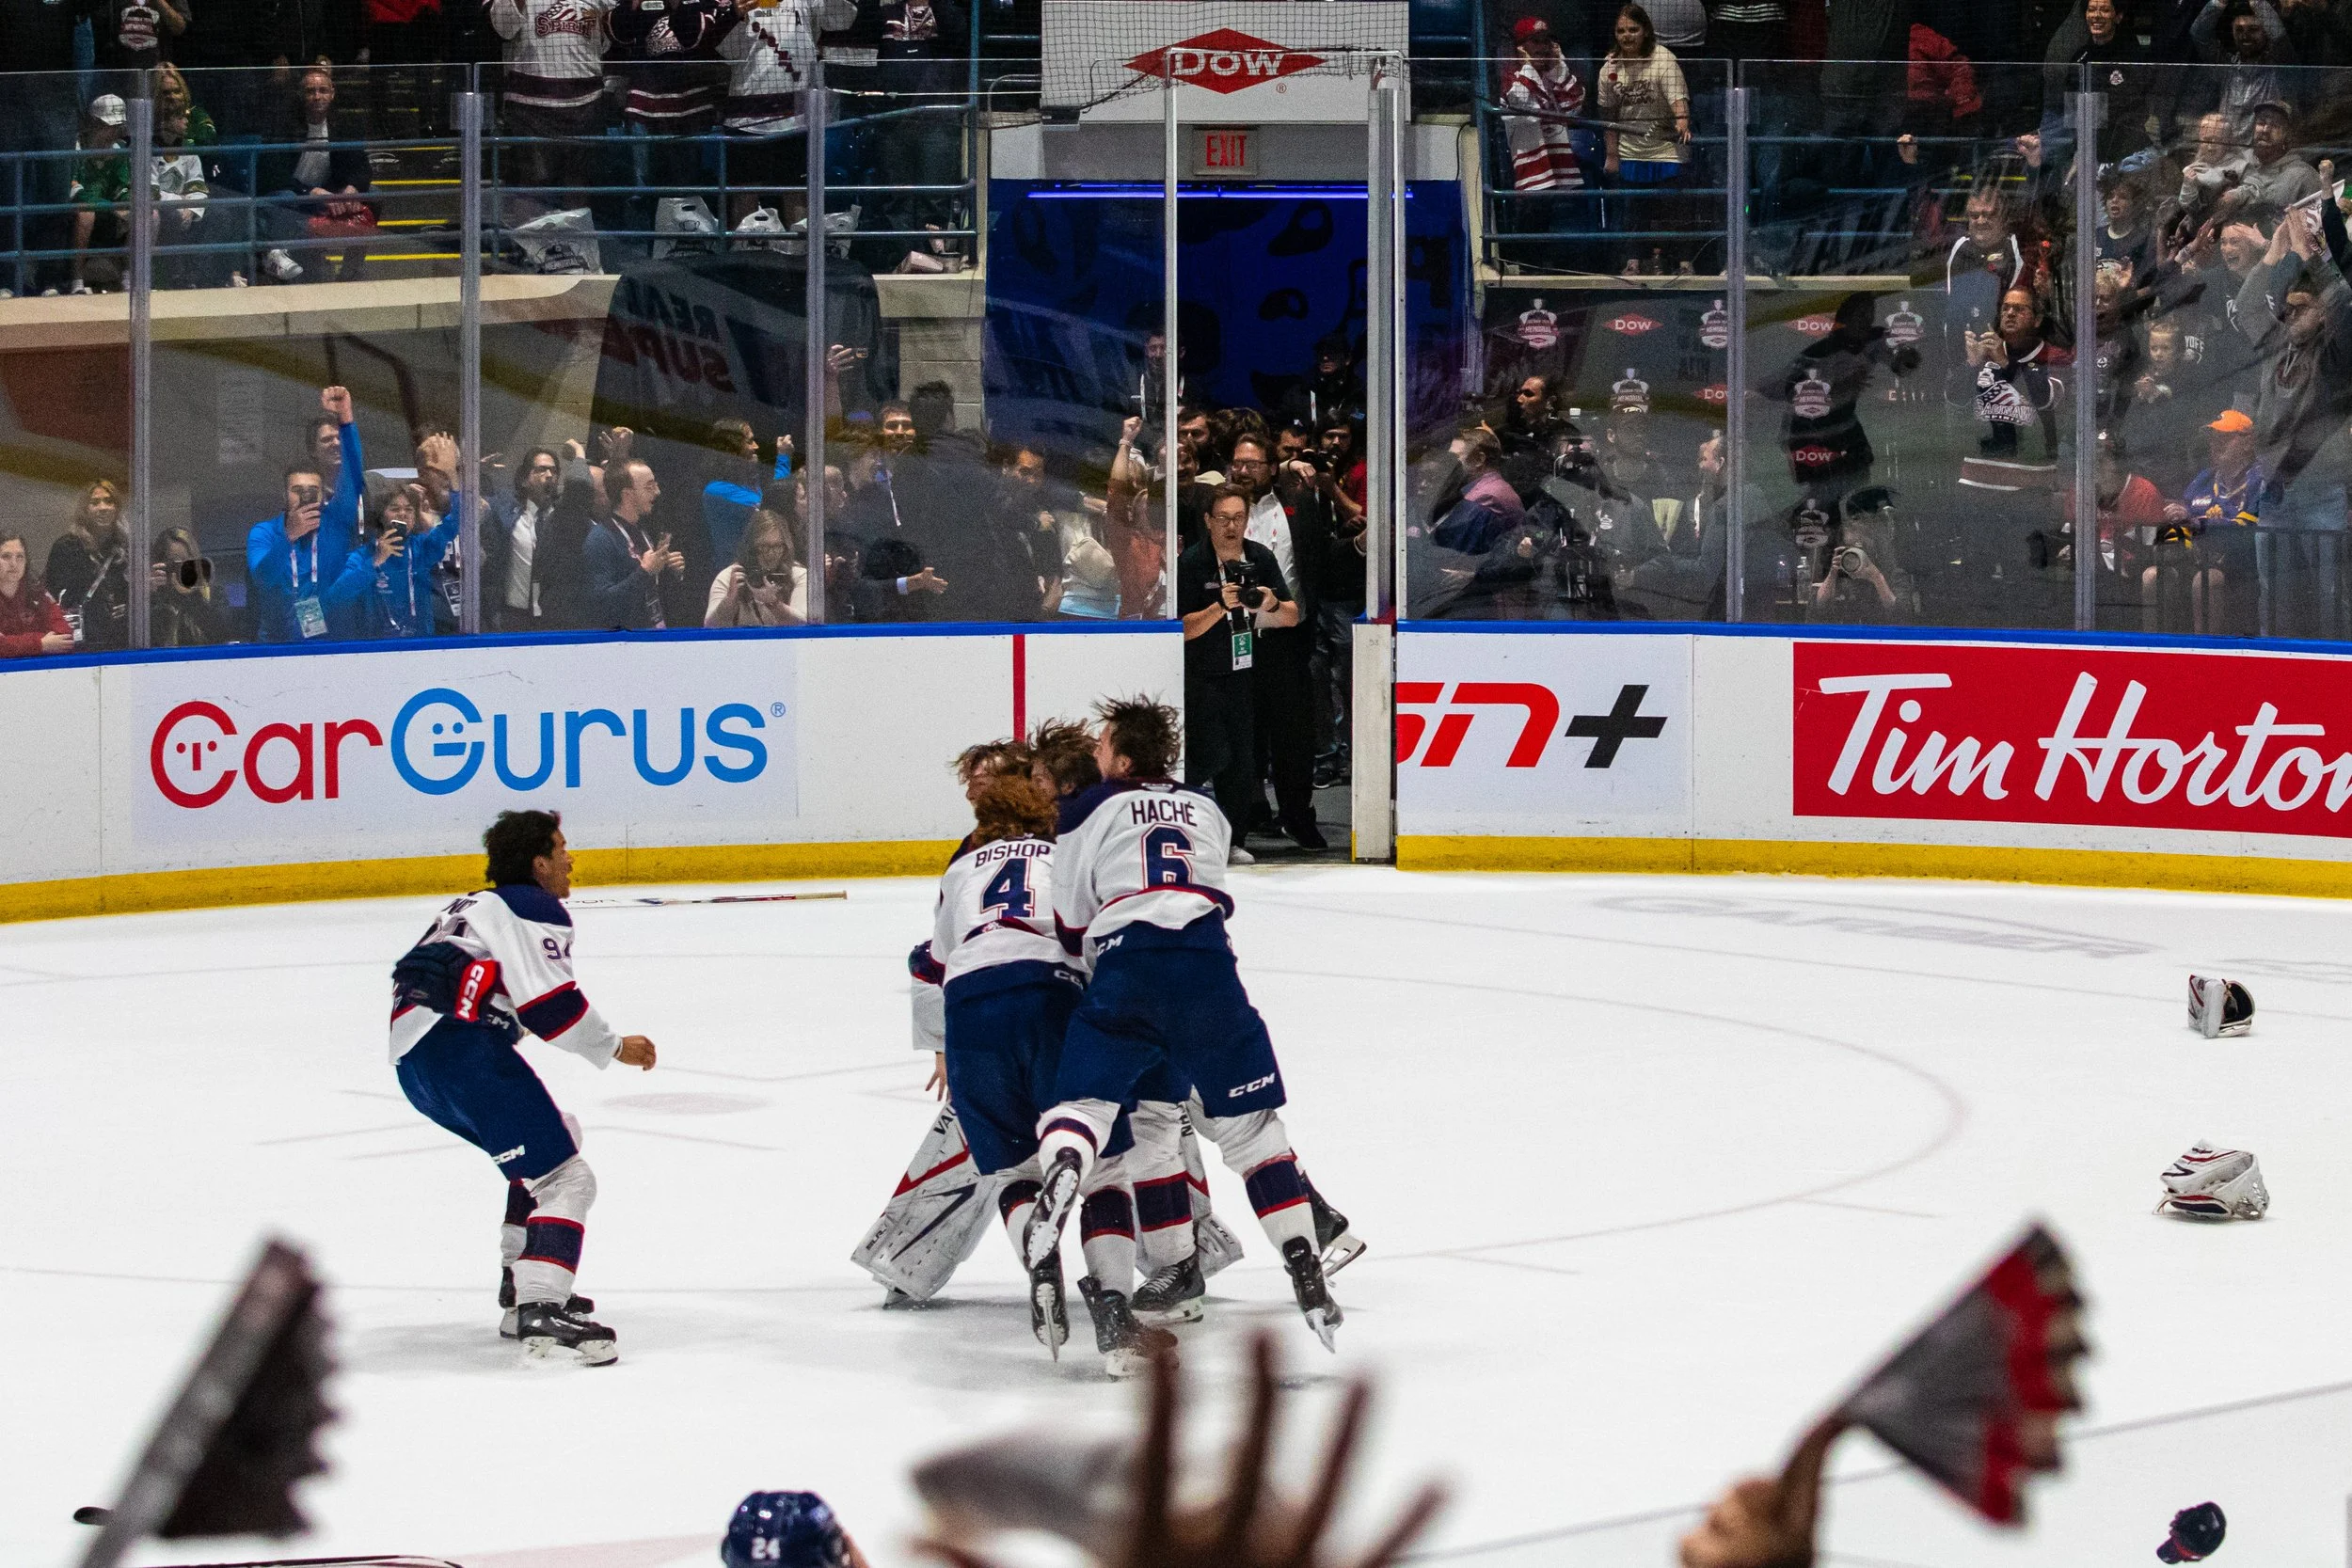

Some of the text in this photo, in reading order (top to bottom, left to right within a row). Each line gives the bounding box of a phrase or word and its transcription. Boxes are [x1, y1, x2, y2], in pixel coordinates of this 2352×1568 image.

[1205, 135, 1248, 166] EXIT
[1818, 672, 2016, 797] Tim
[1131, 799, 1198, 828] HACHÉ
[975, 843, 1051, 868] BISHOP
[1141, 823, 1196, 889] 6
[980, 856, 1036, 918] 4
[457, 964, 485, 1019] CCM
[1228, 1072, 1276, 1099] CCM
[750, 1536, 781, 1560] 24
